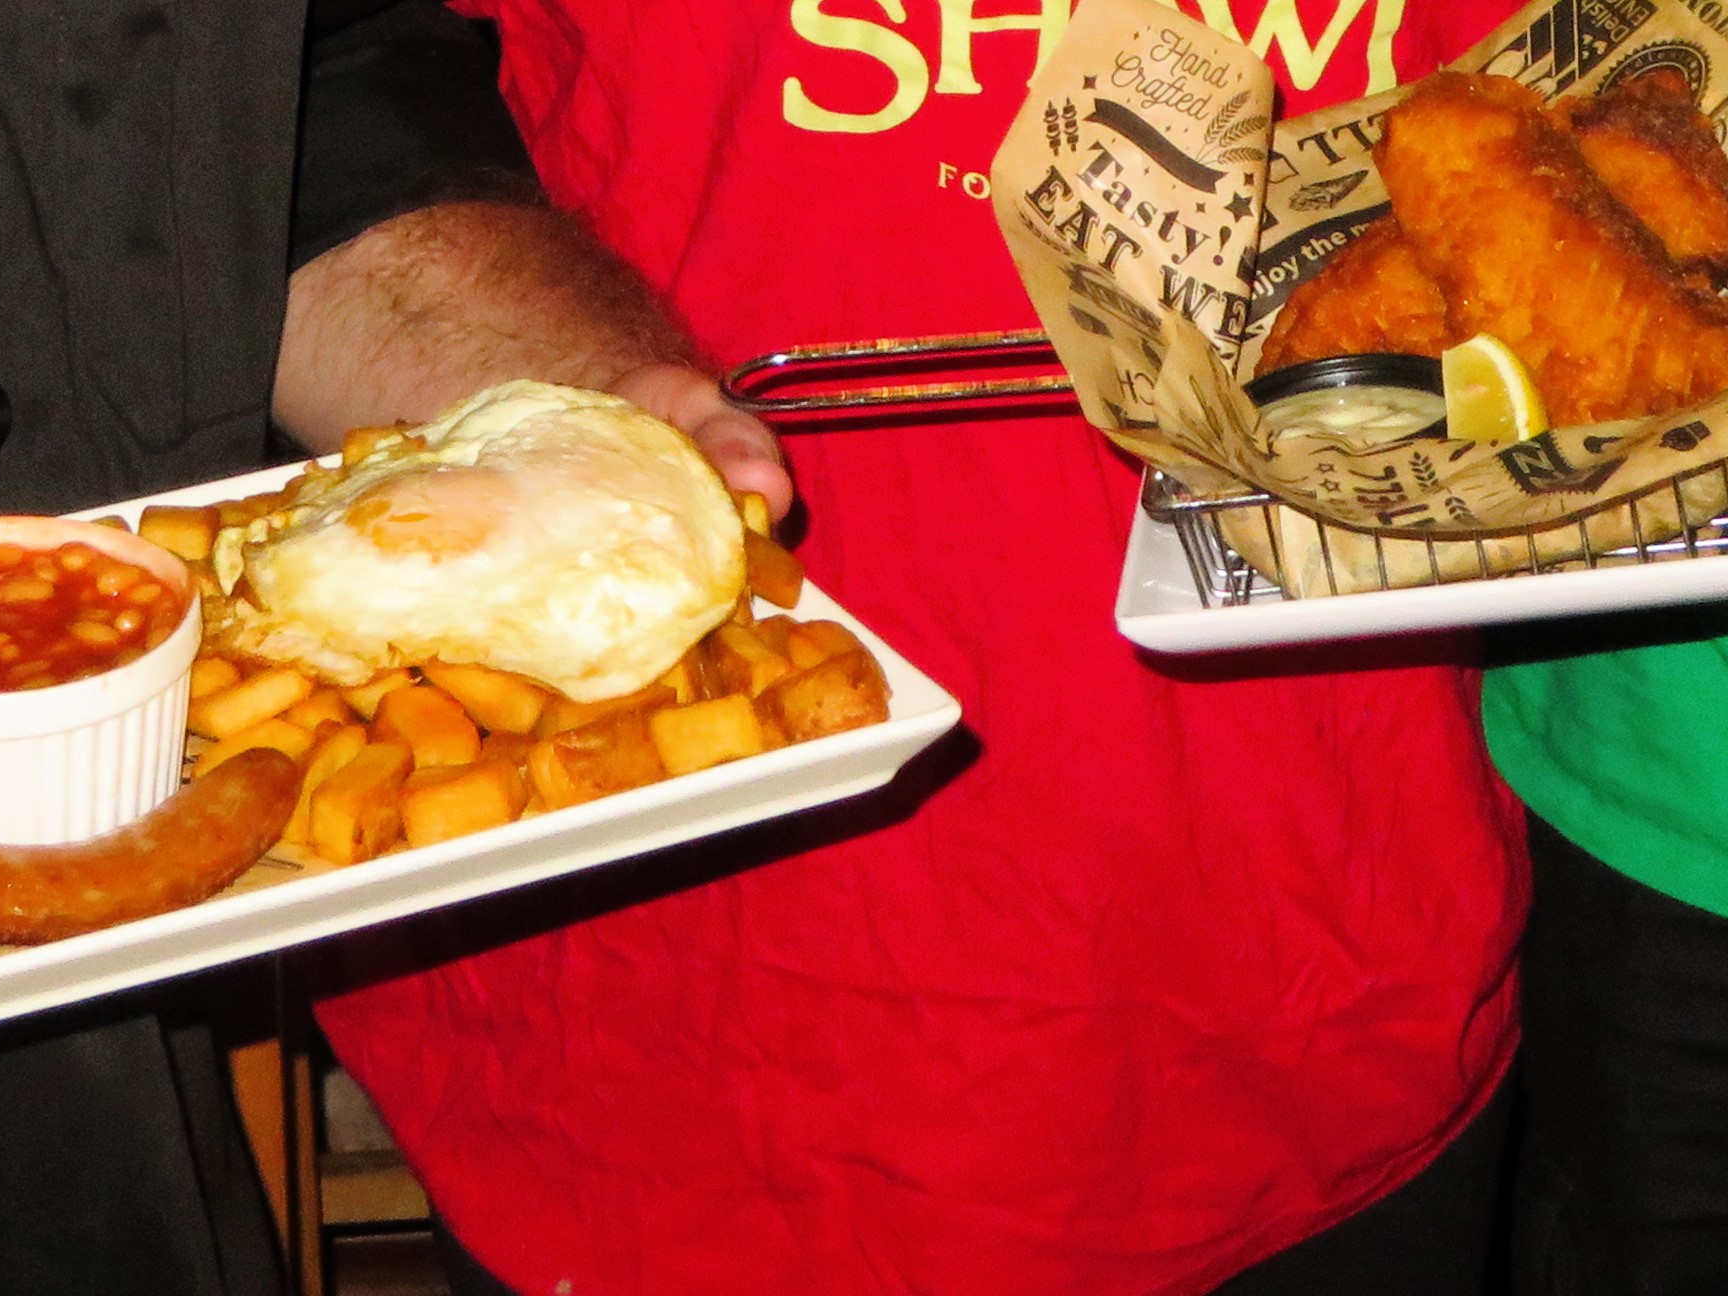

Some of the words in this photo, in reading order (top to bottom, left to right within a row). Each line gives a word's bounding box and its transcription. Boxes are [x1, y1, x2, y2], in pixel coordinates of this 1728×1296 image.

[1110, 49, 1214, 122] Crafted
[1150, 27, 1231, 90] Hand
[1024, 163, 1144, 272] EAT
[1075, 140, 1233, 267] Tasty!
[1300, 229, 1348, 262] the
